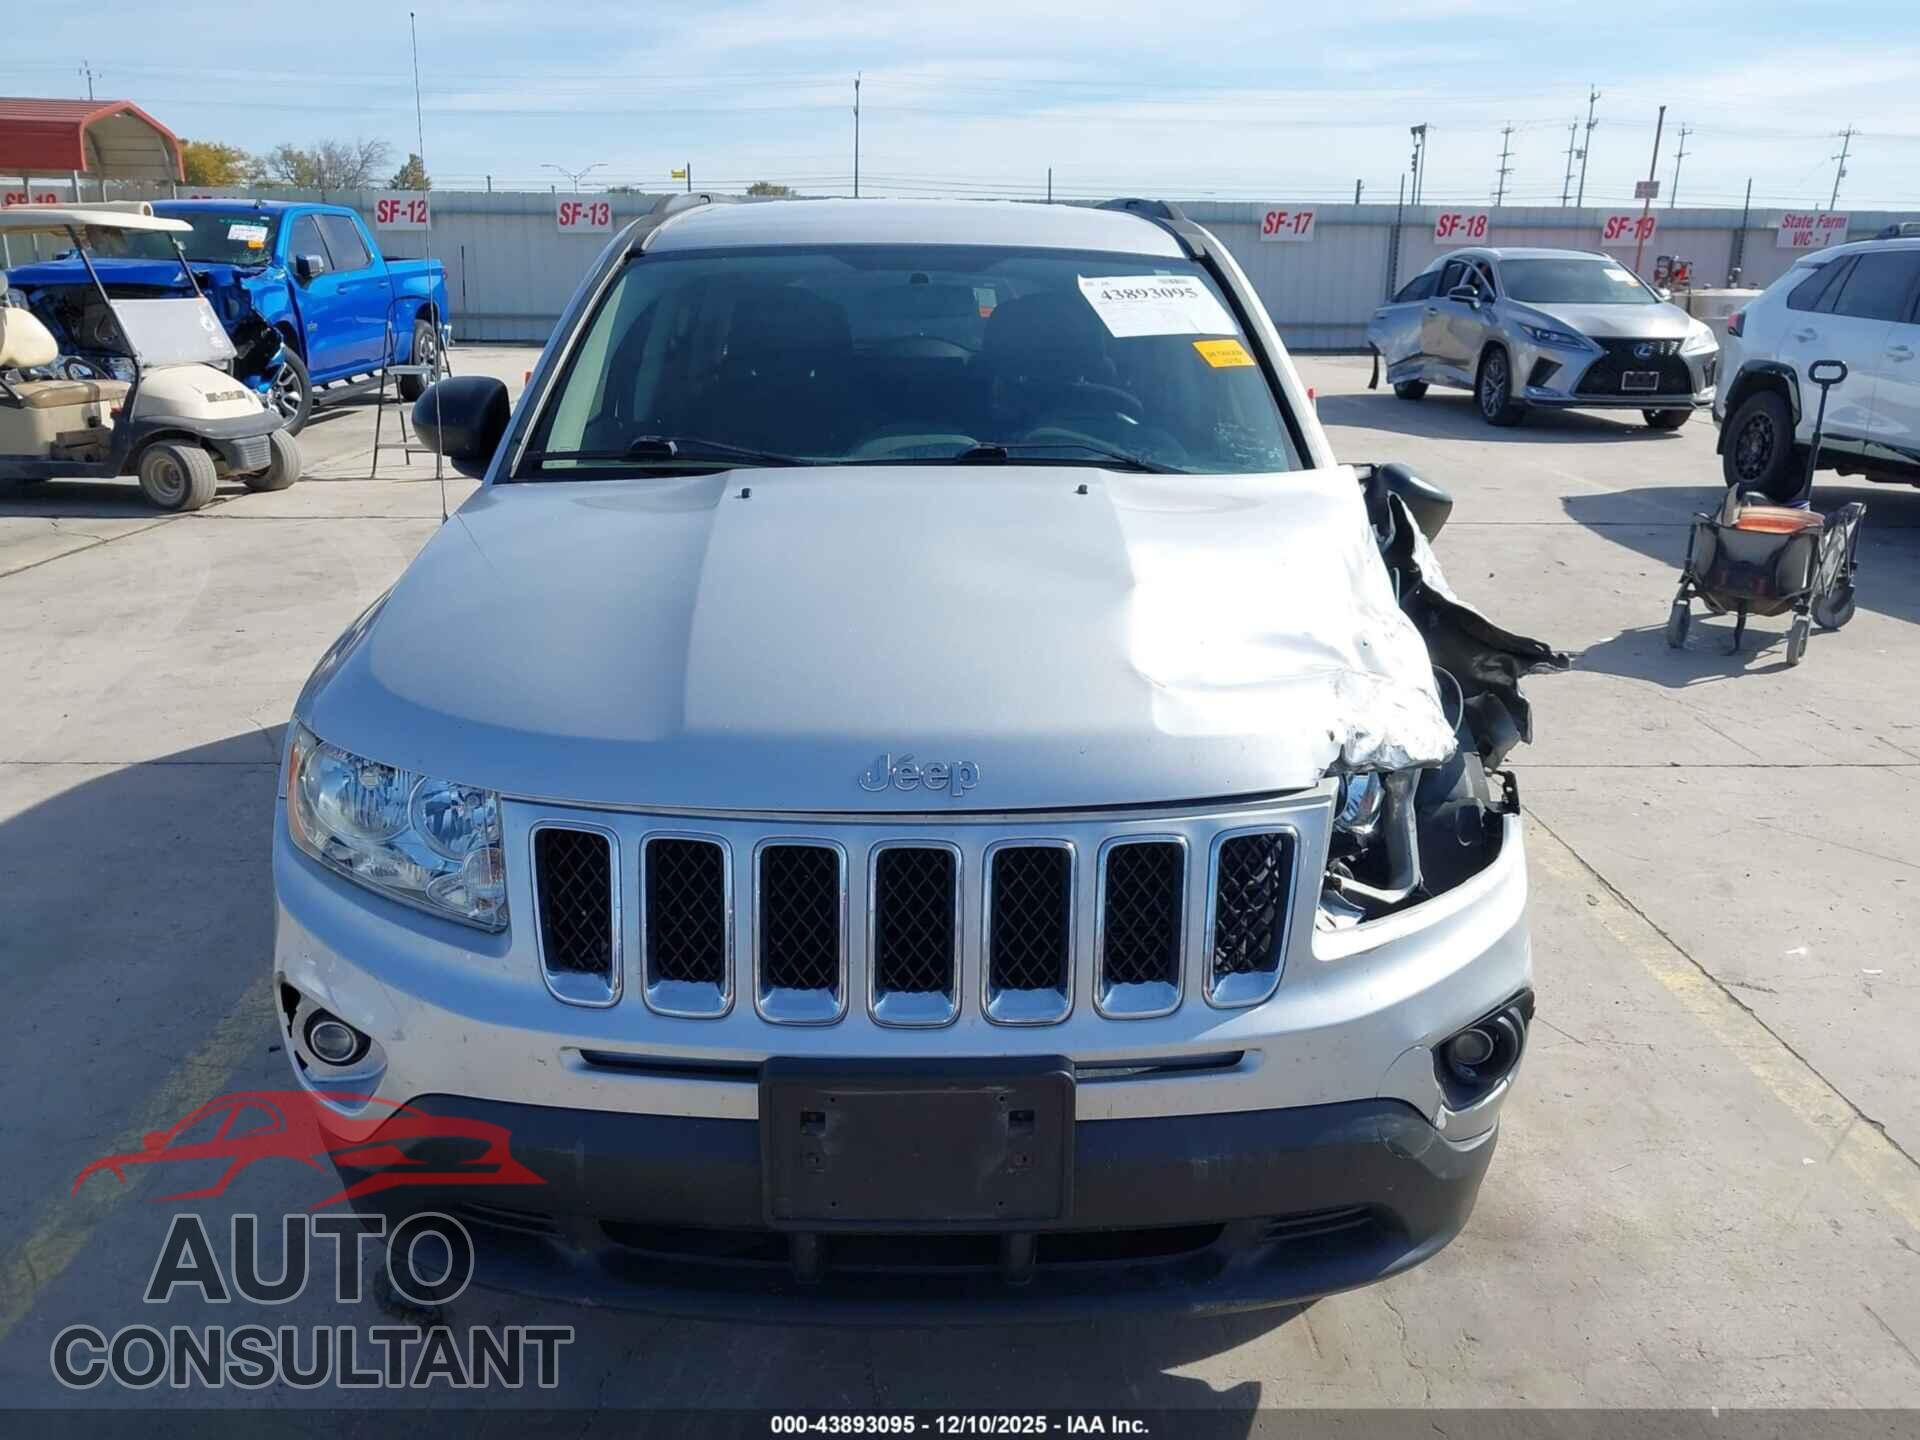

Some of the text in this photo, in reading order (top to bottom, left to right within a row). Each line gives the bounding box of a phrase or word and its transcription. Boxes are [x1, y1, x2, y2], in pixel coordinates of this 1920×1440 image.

[377, 199, 427, 224] SF-12
[559, 201, 610, 226] SF-13
[1263, 211, 1313, 235] SF-17
[1782, 213, 1847, 229] State Farm
[1436, 214, 1488, 238] SF-18
[1101, 287, 1199, 301] 43893095
